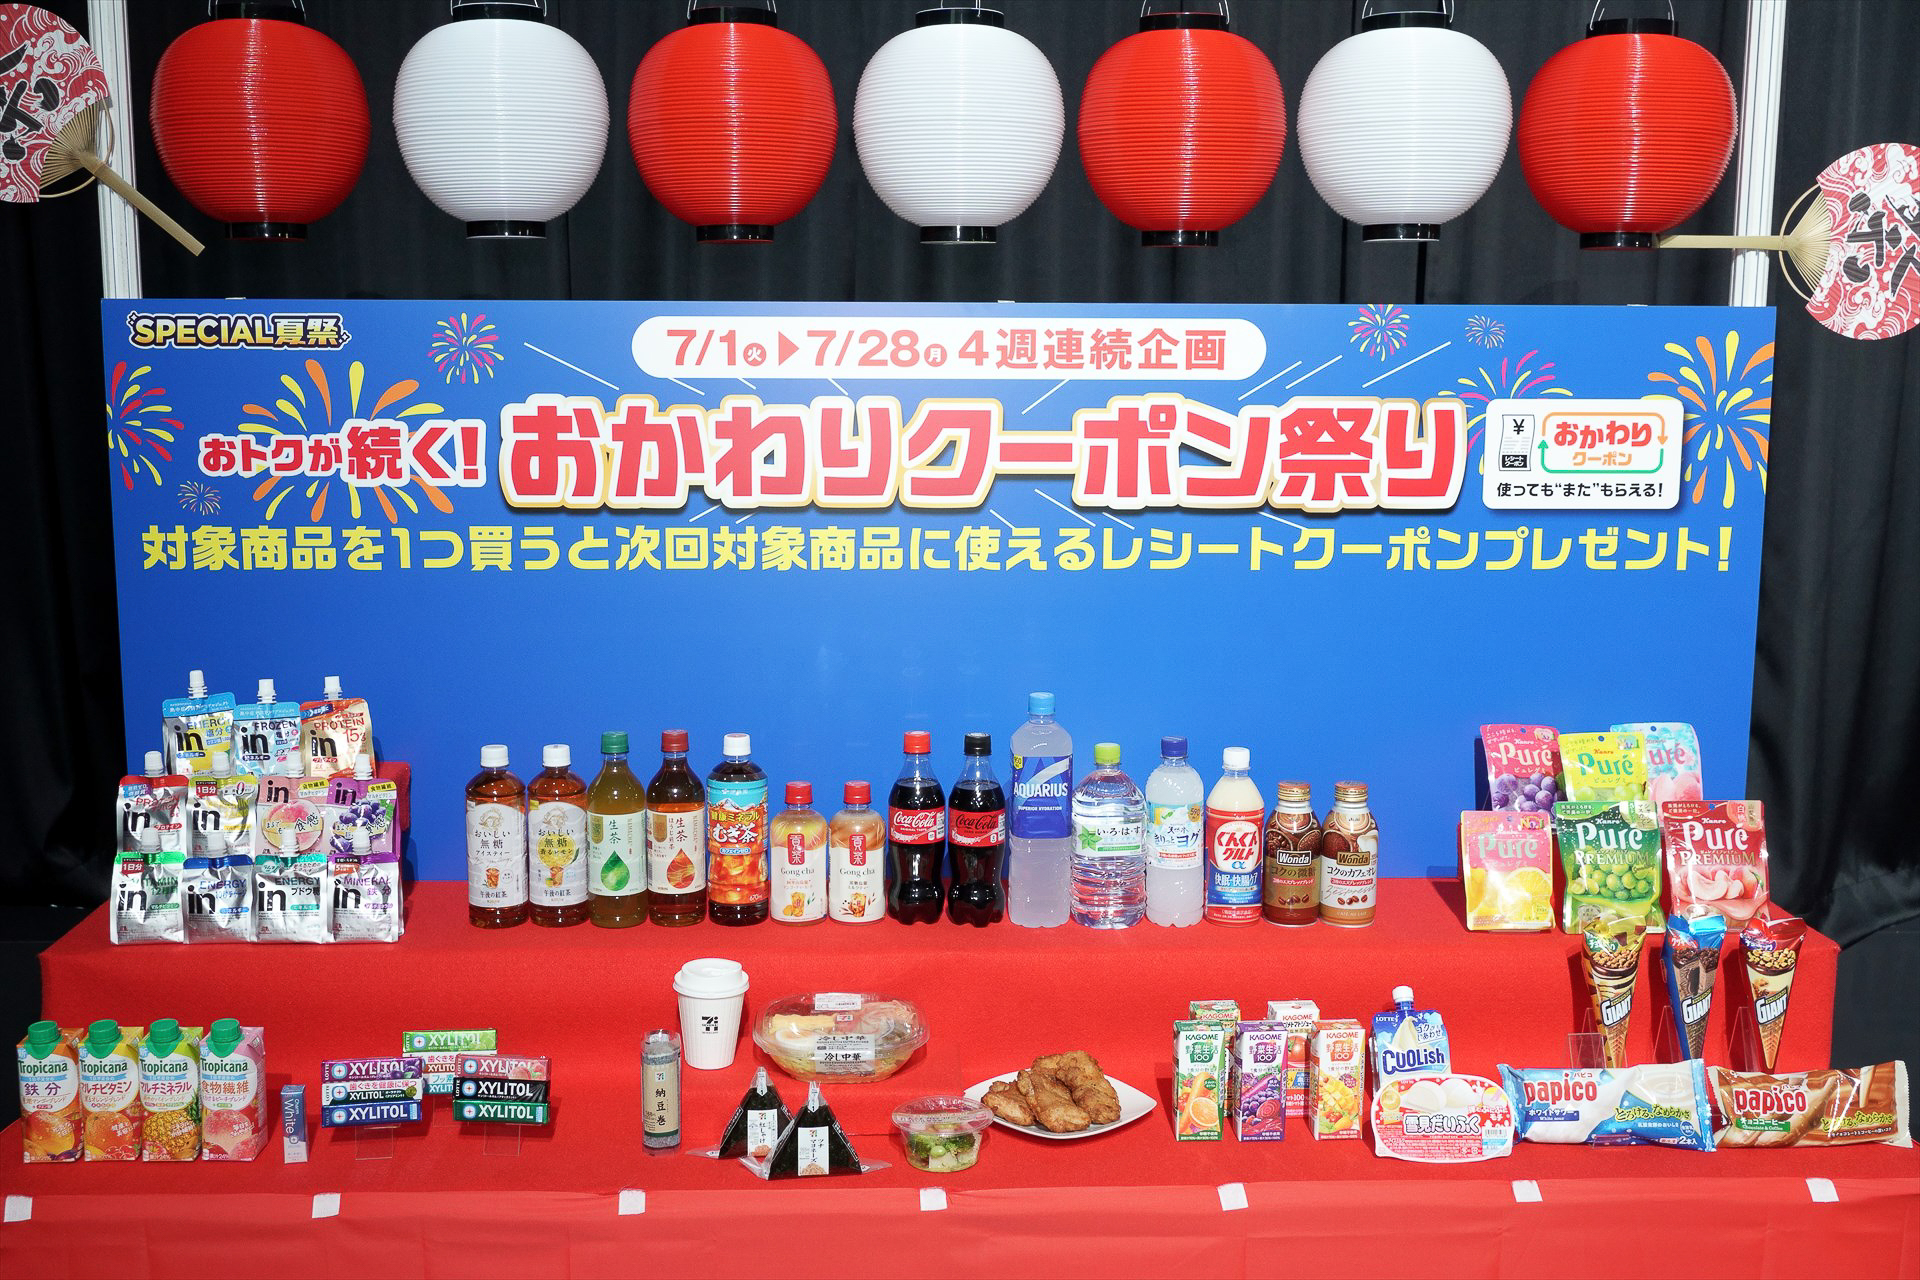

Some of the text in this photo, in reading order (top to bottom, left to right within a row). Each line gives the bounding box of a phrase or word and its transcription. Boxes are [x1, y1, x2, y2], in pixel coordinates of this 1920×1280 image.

[135, 315, 343, 349] SPECIAL夏祭
[1553, 420, 1653, 449] おかわり
[203, 425, 480, 481] おトクが続く!
[508, 400, 1458, 504] おかわりクーポン祭り
[1572, 451, 1633, 466] クーポン
[142, 524, 1733, 573] 対象商品を1つ買うと次回対象商品に使えるレシートクーポンプレゼント!
[254, 720, 297, 731] FROZEN
[313, 717, 365, 731] PROTEIN
[174, 724, 205, 752] in
[240, 726, 269, 754] in
[309, 729, 338, 758] in
[1498, 742, 1553, 766] Puré
[1648, 742, 1686, 766] uré
[1577, 752, 1634, 776] Puré
[196, 786, 217, 794] 1日分
[266, 779, 289, 803] in
[334, 782, 357, 805] in
[1013, 782, 1069, 798] AQUARIUS
[192, 802, 221, 831] in
[711, 811, 761, 822] 健康ミネラル
[893, 811, 937, 828] Coca-Cola
[955, 813, 998, 831] Coca-Cola
[474, 829, 511, 838] おいしい
[538, 828, 574, 837] おいしい
[608, 819, 622, 844] 生茶
[675, 817, 688, 842] 生茶
[712, 821, 759, 844] むぎ茶
[1681, 820, 1750, 851] Puré
[480, 839, 504, 849] 無糖
[544, 837, 568, 848] 無糖
[1216, 831, 1258, 847] ぐんぐん
[1222, 847, 1255, 861] グルト
[1279, 852, 1309, 864] Wonda
[1338, 853, 1369, 865] Wonda
[1573, 849, 1651, 865] PREMIUM
[1679, 850, 1757, 866] PREMIUM
[122, 862, 144, 871] 1日分
[780, 867, 801, 877] Gong
[839, 867, 876, 878] Gong cha
[1271, 866, 1316, 878] コクの微糖
[1326, 866, 1375, 878] コクのカフェオレ
[199, 878, 247, 890] ENERGY
[274, 876, 321, 887] ENERGY
[343, 875, 392, 887] MINERAL
[117, 883, 148, 911] in
[187, 884, 216, 914] in
[258, 881, 287, 911] in
[333, 878, 361, 909] in
[480, 890, 508, 899] 午後の紅茶
[544, 888, 572, 897] 午後の紅茶
[1601, 994, 1631, 1026] GIANT
[1682, 993, 1712, 1024] GIANT
[1755, 993, 1787, 1024] GIANT
[429, 1033, 481, 1047] XYLITOL
[824, 1052, 862, 1061] 冷し中華
[1257, 1054, 1273, 1062] 100
[1334, 1052, 1350, 1060] 100
[18, 1060, 68, 1076] Tropicana
[80, 1059, 128, 1075] Tropicana
[140, 1059, 188, 1075] Tropicana
[200, 1058, 248, 1074] Tropicana
[349, 1061, 405, 1076] XYLITOL
[428, 1064, 456, 1072] XYLITO
[480, 1059, 531, 1073] XYLITOL
[24, 1082, 62, 1096] 鉄分
[80, 1081, 132, 1095] マルチビタミン
[140, 1081, 193, 1095] マルチミネラル
[201, 1080, 249, 1095] 食物繊維
[350, 1080, 417, 1091] 歯ぐきを健康に保つ
[429, 1084, 454, 1093] XYLIT
[478, 1081, 534, 1097] XYLITOL
[1523, 1072, 1598, 1106] papico
[350, 1091, 384, 1100] XYLITOL
[1734, 1086, 1807, 1115] papico
[349, 1105, 408, 1121] XYLITOL
[478, 1104, 534, 1119] XYLITOL
[655, 1087, 667, 1126] 納豆巻
[1615, 1103, 1692, 1122] とろける、なめらかさ
[284, 1098, 297, 1134] White
[1405, 1113, 1480, 1134] 雪見だいふく
[1678, 1135, 1698, 1146] 2本入
